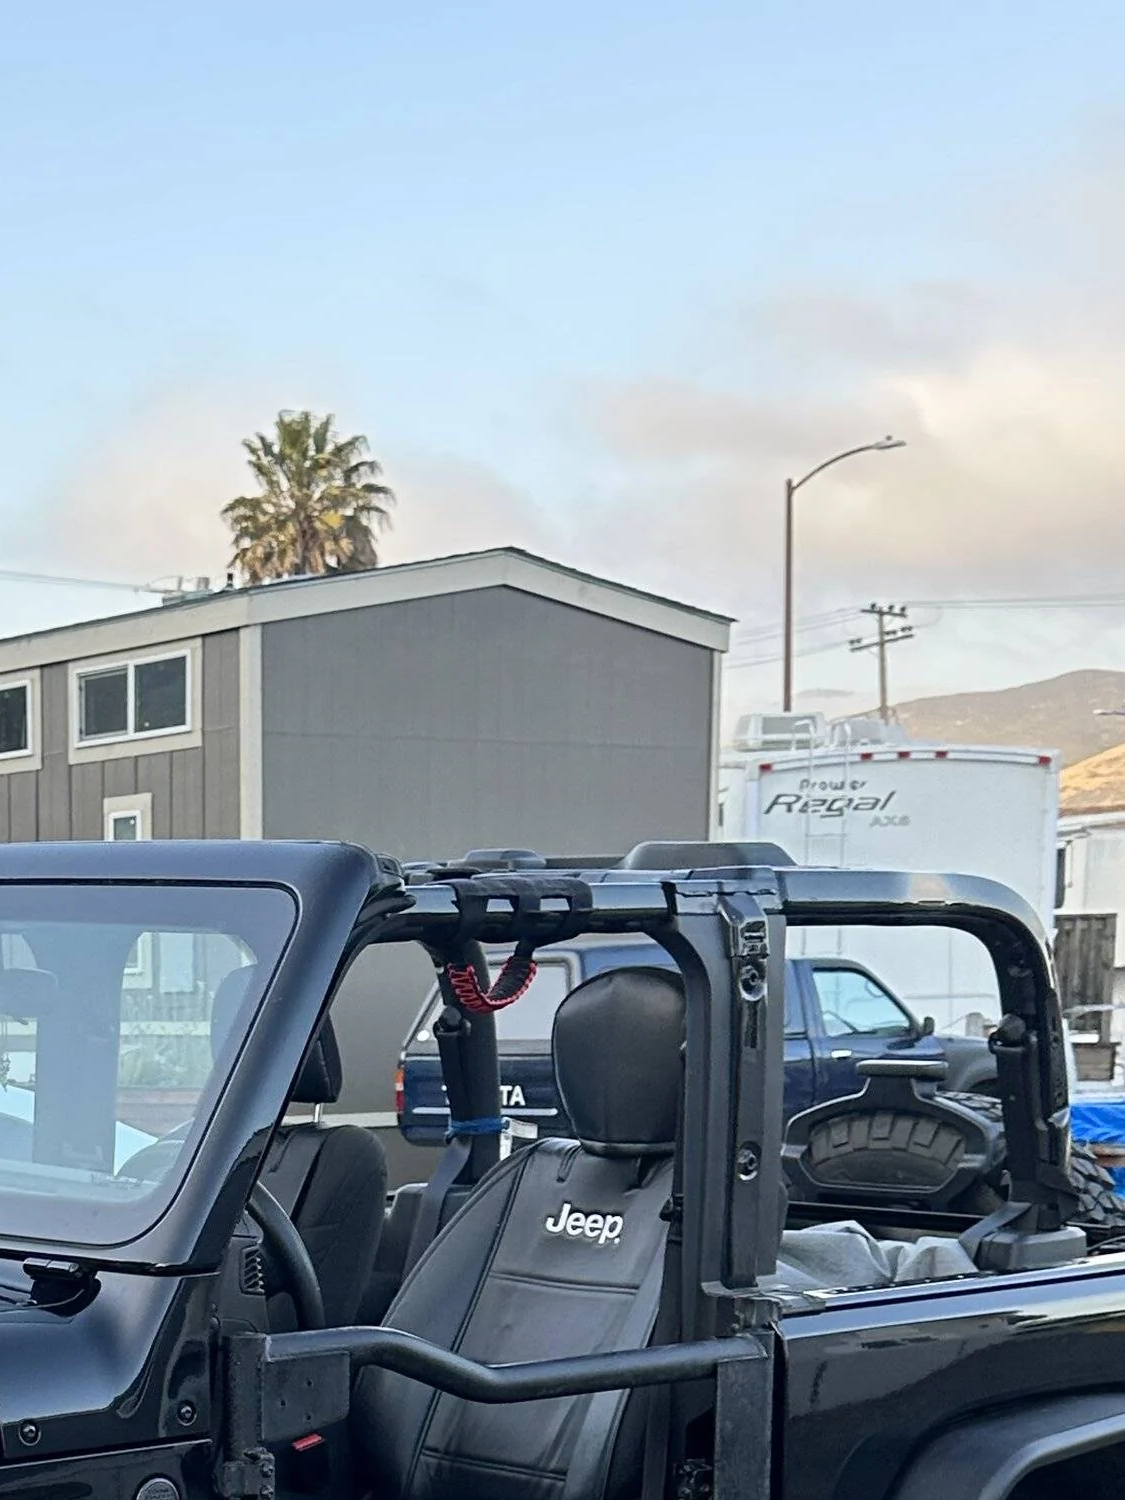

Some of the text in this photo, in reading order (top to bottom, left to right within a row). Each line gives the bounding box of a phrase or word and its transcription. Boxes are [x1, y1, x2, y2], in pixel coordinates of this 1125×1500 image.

[799, 779, 868, 792] Prower
[763, 789, 897, 819] Regal
[545, 1201, 623, 1244] Jeep
